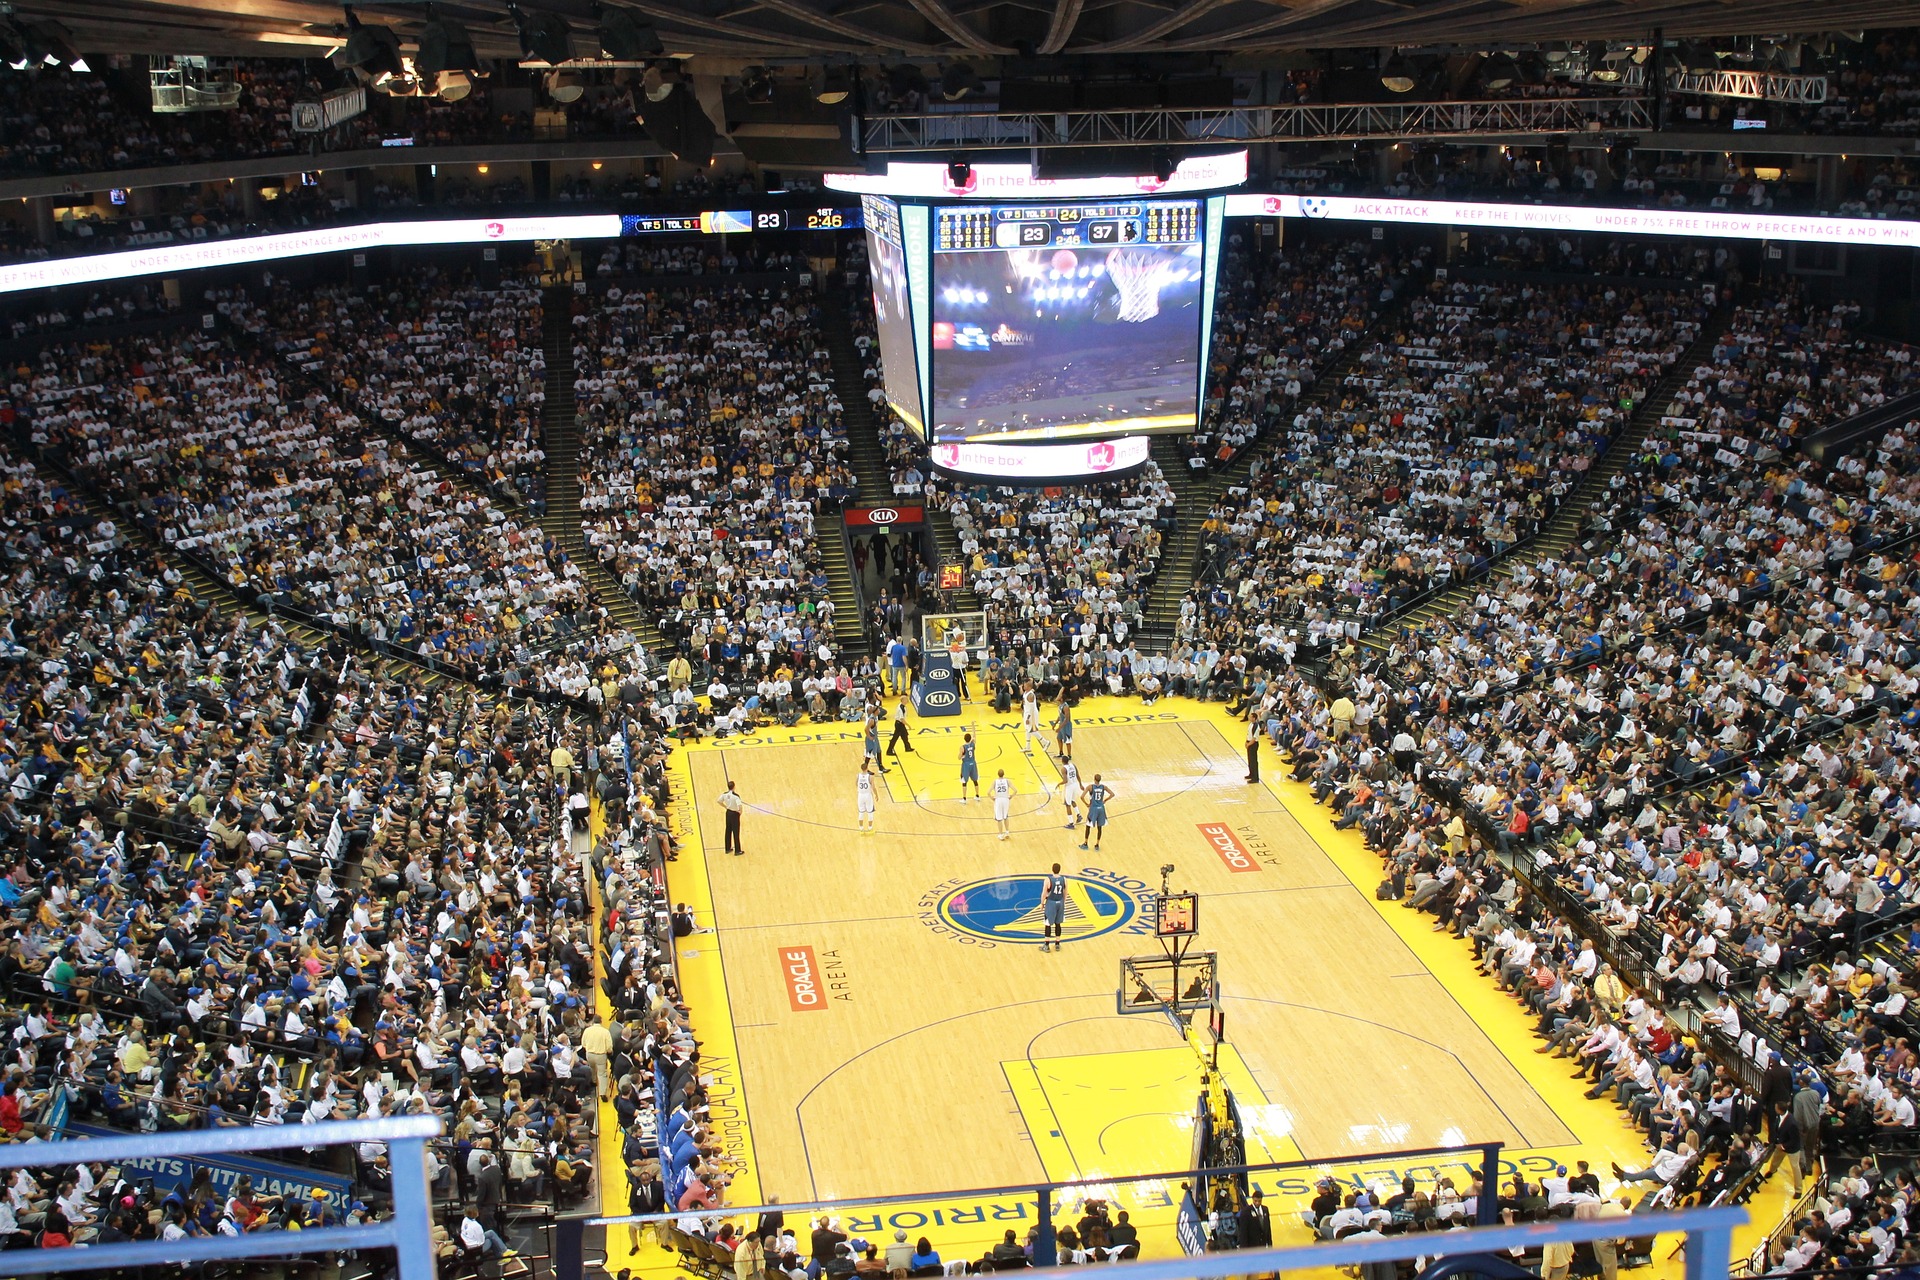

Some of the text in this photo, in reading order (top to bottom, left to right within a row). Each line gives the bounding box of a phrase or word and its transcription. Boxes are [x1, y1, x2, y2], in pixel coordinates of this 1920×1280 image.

[999, 174, 1024, 186] the
[1003, 211, 1013, 219] TF
[1014, 210, 1021, 218] 5
[1059, 208, 1079, 221] 24
[1119, 207, 1129, 215] TF
[1354, 204, 1429, 217] JACK ATTACK
[1455, 209, 1484, 220] KEEP
[1488, 211, 1508, 221] THE
[643, 221, 653, 230] TF
[653, 221, 662, 230] 5
[666, 220, 682, 230] TOL
[683, 219, 692, 230] 5
[757, 213, 780, 228] 23
[807, 215, 843, 228] 2:46
[1595, 215, 1637, 227] UNDER
[1643, 217, 1664, 227] 75%
[1669, 218, 1699, 229] FREE
[1705, 220, 1751, 231] THROW
[1756, 222, 1842, 236] PERCENTAGE
[1848, 227, 1876, 237] AND
[1023, 227, 1044, 242] 23
[1092, 226, 1113, 239] 37
[131, 255, 169, 269] UNDER
[197, 249, 223, 261] FREE
[226, 245, 264, 257] THROW
[269, 235, 334, 252] PERCENTAGE
[338, 232, 358, 244] AND
[1205, 206, 1220, 293] JAWBONE
[908, 215, 926, 304] JAWBONE
[23, 270, 46, 281] THE
[962, 452, 1024, 466] in the box
[873, 511, 894, 521] KIA
[942, 573, 961, 589] 24
[932, 670, 947, 679] KIA
[929, 696, 951, 705] KIA
[712, 731, 863, 747] GOLDEN
[968, 750, 973, 758] 9
[859, 782, 869, 790] 30
[997, 785, 1007, 793] 25
[1095, 792, 1102, 801] 13
[676, 807, 694, 837] Samsung
[1205, 826, 1250, 868] ORACLE
[1237, 825, 1281, 866] ARENA
[1053, 884, 1063, 895] 42
[917, 876, 997, 949] GOLDEN STATE
[786, 951, 818, 1005] ORACLE
[822, 949, 853, 1002] ARENA
